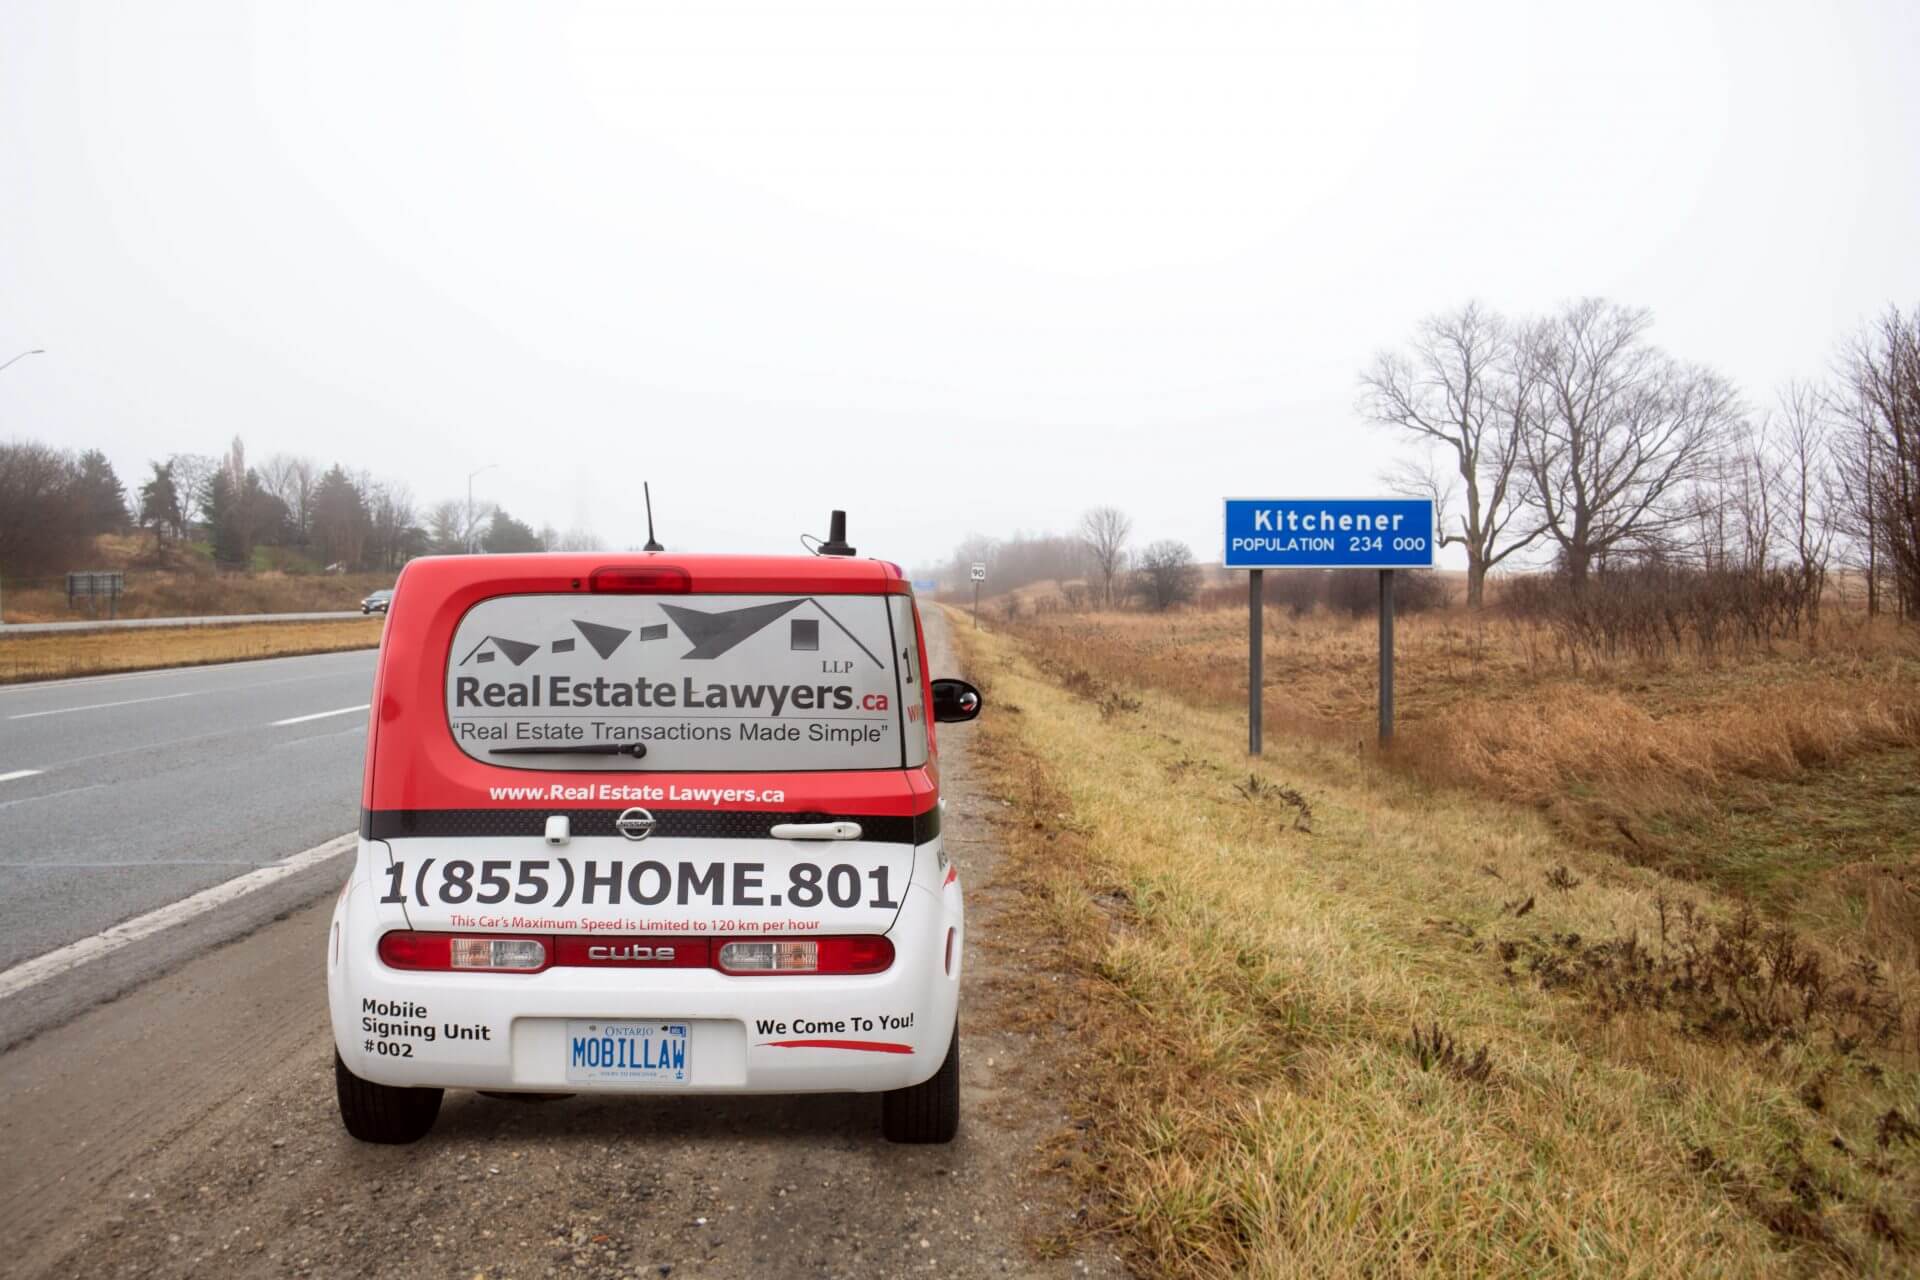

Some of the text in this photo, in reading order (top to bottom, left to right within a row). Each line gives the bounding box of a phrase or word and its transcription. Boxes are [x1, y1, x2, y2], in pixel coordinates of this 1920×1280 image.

[1254, 509, 1404, 531] Kitchener
[1232, 536, 1426, 551] POPULATION 234 000
[972, 569, 984, 577] 90
[822, 660, 854, 674] LLP
[456, 675, 541, 708] Real
[549, 676, 677, 708] Estate
[516, 722, 584, 740] Estate
[591, 722, 732, 741] Transactions
[739, 722, 801, 741] Made
[489, 784, 785, 806] www.Real Estate Lawyers.ca
[451, 914, 476, 928] This
[512, 917, 577, 930] Maximum
[581, 918, 622, 931] Speed
[626, 918, 637, 930] is
[640, 919, 689, 931] Limited
[693, 920, 707, 931] to
[711, 920, 735, 931] 120
[738, 919, 759, 931] km
[763, 920, 784, 933] per
[788, 919, 820, 931] hour
[588, 944, 676, 960] cube
[362, 1017, 491, 1042] Signing Unit
[756, 1012, 914, 1035] We Come To You!
[364, 1039, 414, 1058] #002
[572, 1037, 685, 1069] MOBILLAW
